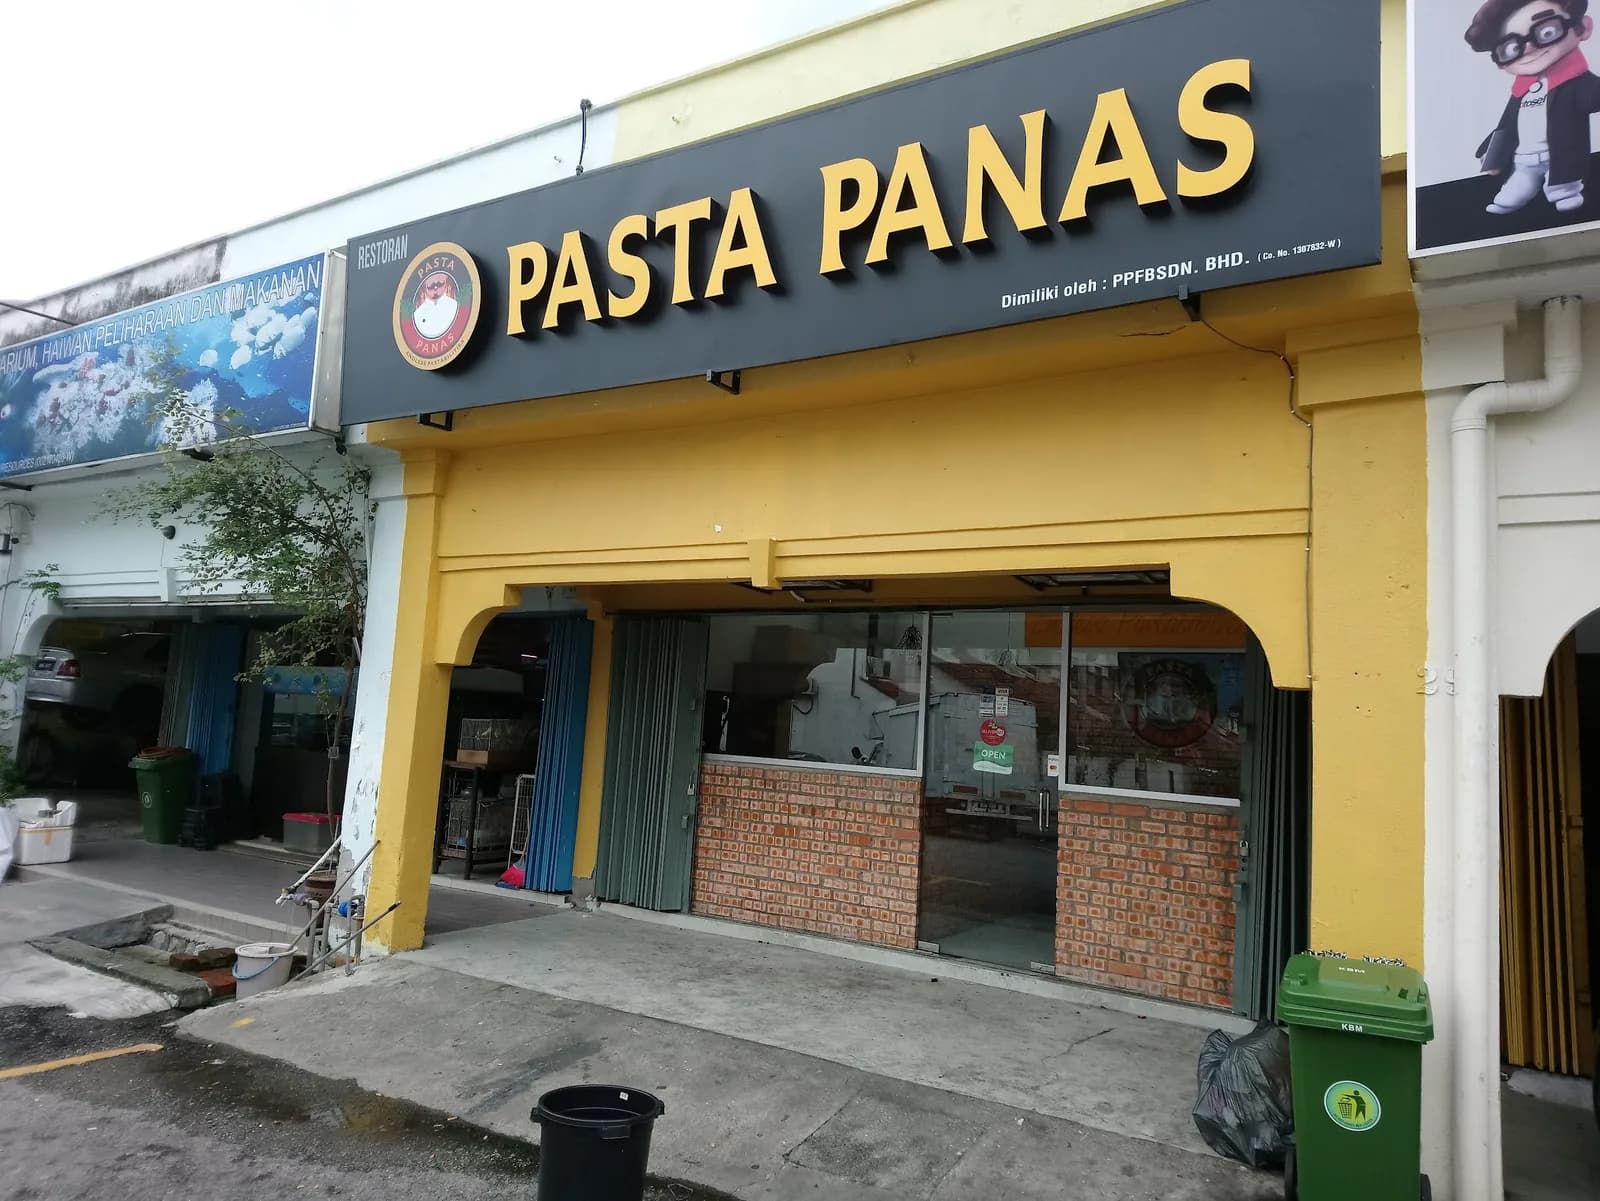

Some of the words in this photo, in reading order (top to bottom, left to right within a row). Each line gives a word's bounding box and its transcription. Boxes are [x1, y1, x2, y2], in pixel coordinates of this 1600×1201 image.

[506, 186, 777, 336] PASTA
[820, 58, 1254, 276] PANAS
[358, 234, 408, 270] RESTORAN
[417, 257, 455, 278] PASTA
[1001, 285, 1059, 309] Dimiliki
[1063, 279, 1097, 297] oleh
[1112, 260, 1198, 288] PPFBSDN.
[1205, 251, 1250, 272] BHD.
[41, 328, 93, 365] HAIWAN
[95, 301, 187, 350] PELIHARAAN
[190, 288, 225, 323] DAN
[230, 260, 321, 313] MAKANAN
[415, 332, 455, 353] PANAS
[981, 749, 1006, 760] OPEN
[1341, 1023, 1363, 1033] KBM
